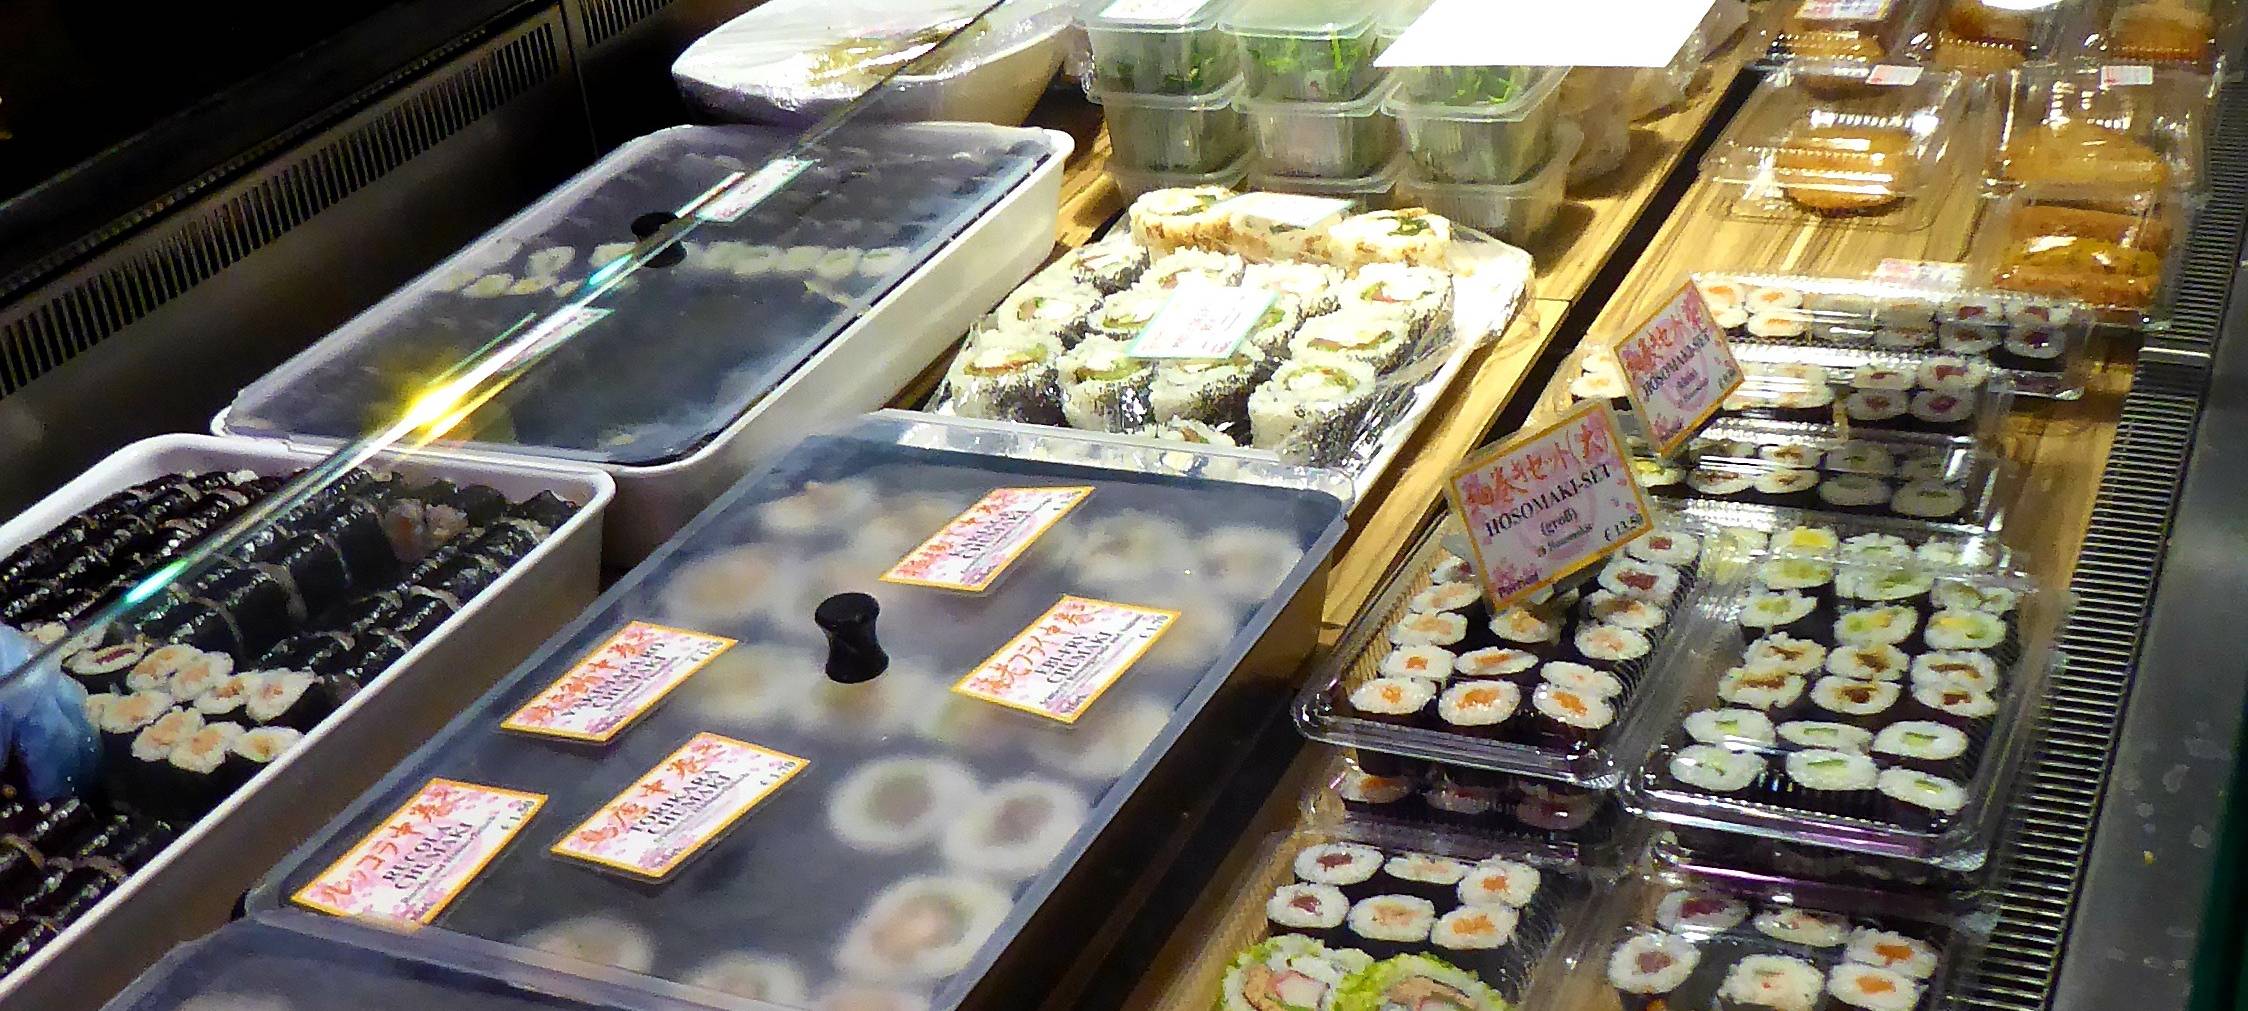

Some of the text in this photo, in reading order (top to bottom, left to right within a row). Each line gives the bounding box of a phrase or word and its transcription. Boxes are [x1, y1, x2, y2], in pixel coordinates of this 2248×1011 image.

[1483, 461, 1611, 538] HOSOMAKI-SET
[1033, 633, 1089, 675] EBI-FRY
[1043, 630, 1114, 685] CHUMAKI
[627, 767, 721, 832] TORIKARA
[644, 773, 733, 836] CHUMAKI
[379, 823, 453, 881] RUCOLA
[391, 821, 475, 890] CHUMAKI
